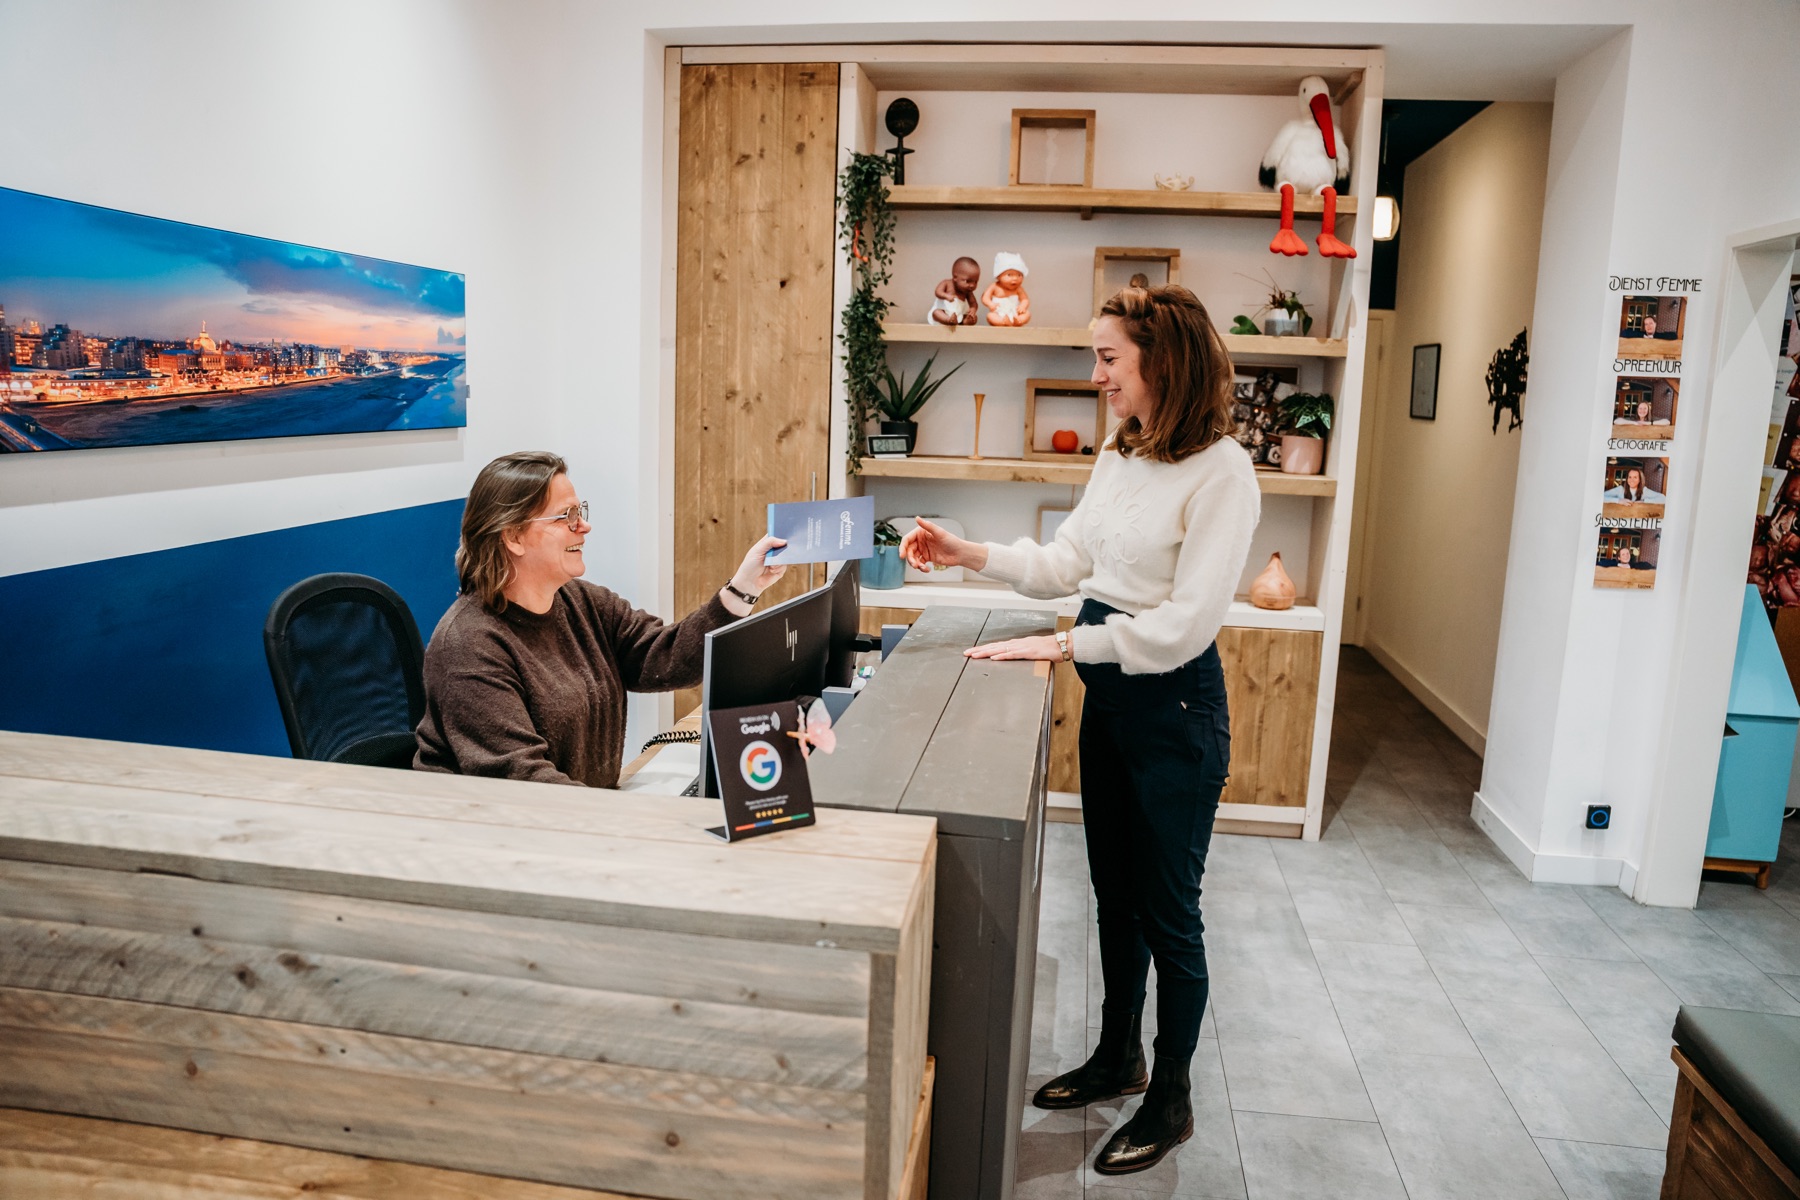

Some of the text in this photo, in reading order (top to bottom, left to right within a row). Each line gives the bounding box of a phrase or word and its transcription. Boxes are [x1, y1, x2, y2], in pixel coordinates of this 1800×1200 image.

[1609, 276, 1702, 292] DIENST FEMME
[1613, 359, 1682, 373] SPREEKUUR
[1608, 438, 1668, 451] ECHOGRAFIE
[740, 721, 771, 735] Google
